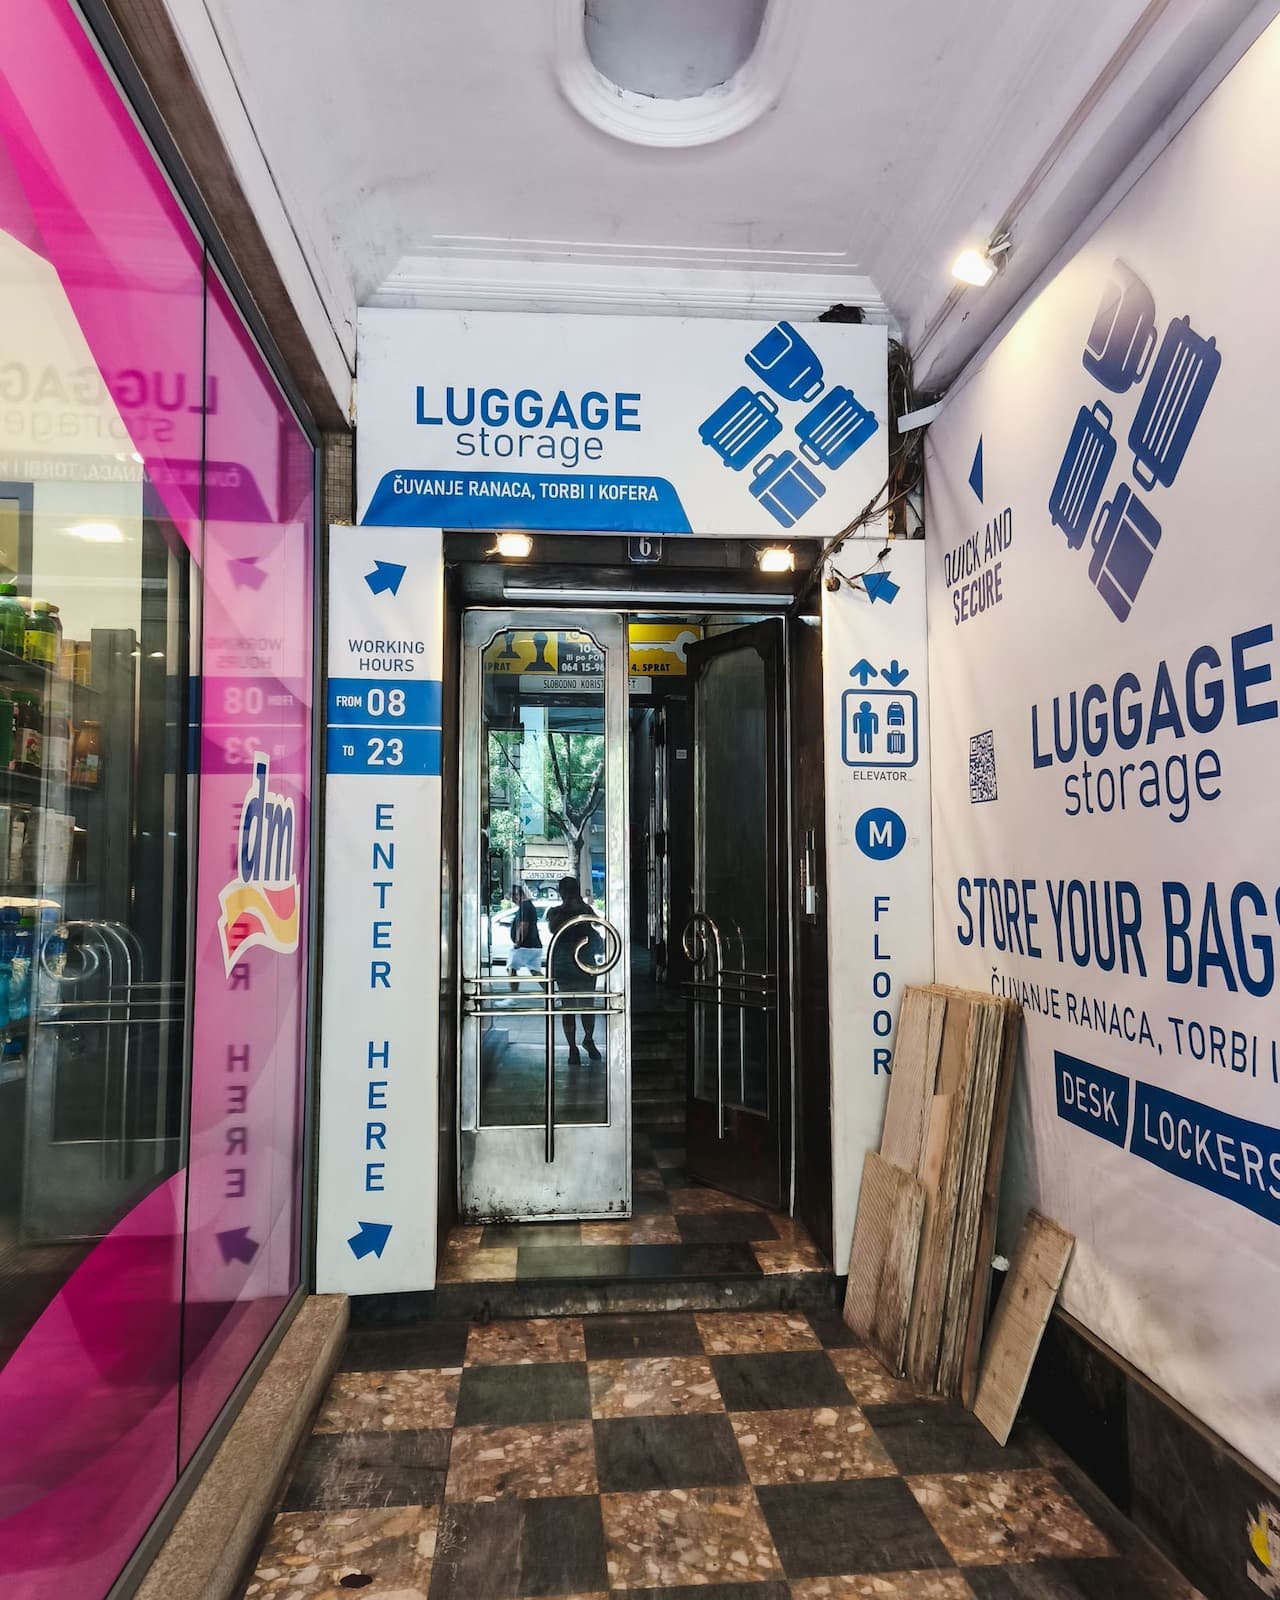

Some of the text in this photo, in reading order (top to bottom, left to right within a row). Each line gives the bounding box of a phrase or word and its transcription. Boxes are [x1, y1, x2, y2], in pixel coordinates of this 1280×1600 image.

[416, 386, 641, 431] LUGGAGE
[456, 427, 603, 467] storage
[393, 475, 658, 502] ČUVANJE RANACA, TORBI I KOFERA
[639, 536, 652, 556] 6
[944, 507, 1012, 588] QUICK AND
[953, 561, 1003, 626] SECURE
[349, 640, 425, 654] WORKING
[360, 658, 415, 672] HOURS
[562, 662, 578, 672] 064
[631, 664, 671, 672] 4. SPRAT
[336, 688, 406, 717] FROM 08
[543, 679, 604, 689] SLOBODNO KORIST
[1032, 624, 1278, 769] LUGGAGE
[342, 737, 404, 766] TO 23
[853, 771, 907, 781] ELEVATOR
[1065, 748, 1221, 823] storage
[242, 763, 295, 882] dm
[869, 821, 893, 848] M
[370, 804, 395, 989] ENTER
[957, 877, 1280, 998] STORE YOUR BAG
[873, 896, 892, 1075] FLOOR
[1066, 993, 1162, 1056] RANACA,
[1168, 1017, 1257, 1078] TORBI
[365, 1041, 390, 1192] HERE
[1063, 1071, 1119, 1127] DESK
[1144, 1103, 1280, 1201] LOCKERS
